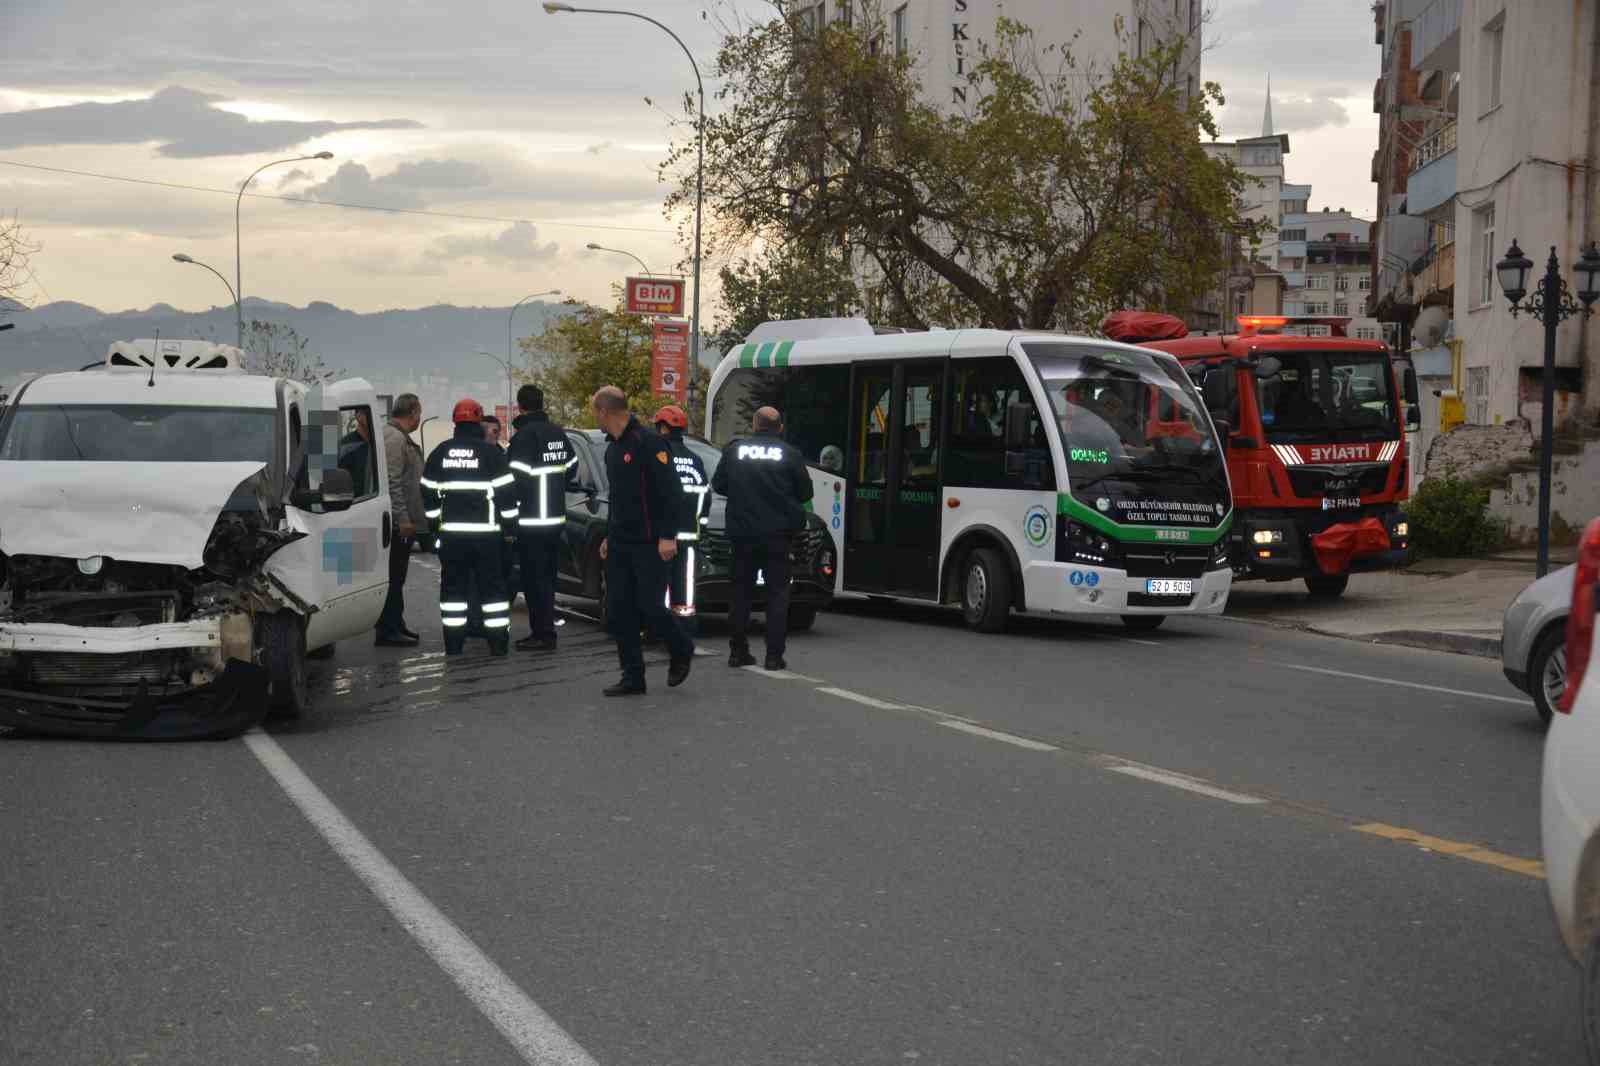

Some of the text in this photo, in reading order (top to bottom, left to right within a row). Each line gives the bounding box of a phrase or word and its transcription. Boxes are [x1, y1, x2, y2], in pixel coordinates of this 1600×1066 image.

[448, 448, 474, 458] ORDU
[1127, 511, 1145, 521] ÖZEL
[1152, 581, 1191, 592] 52 D 5019
